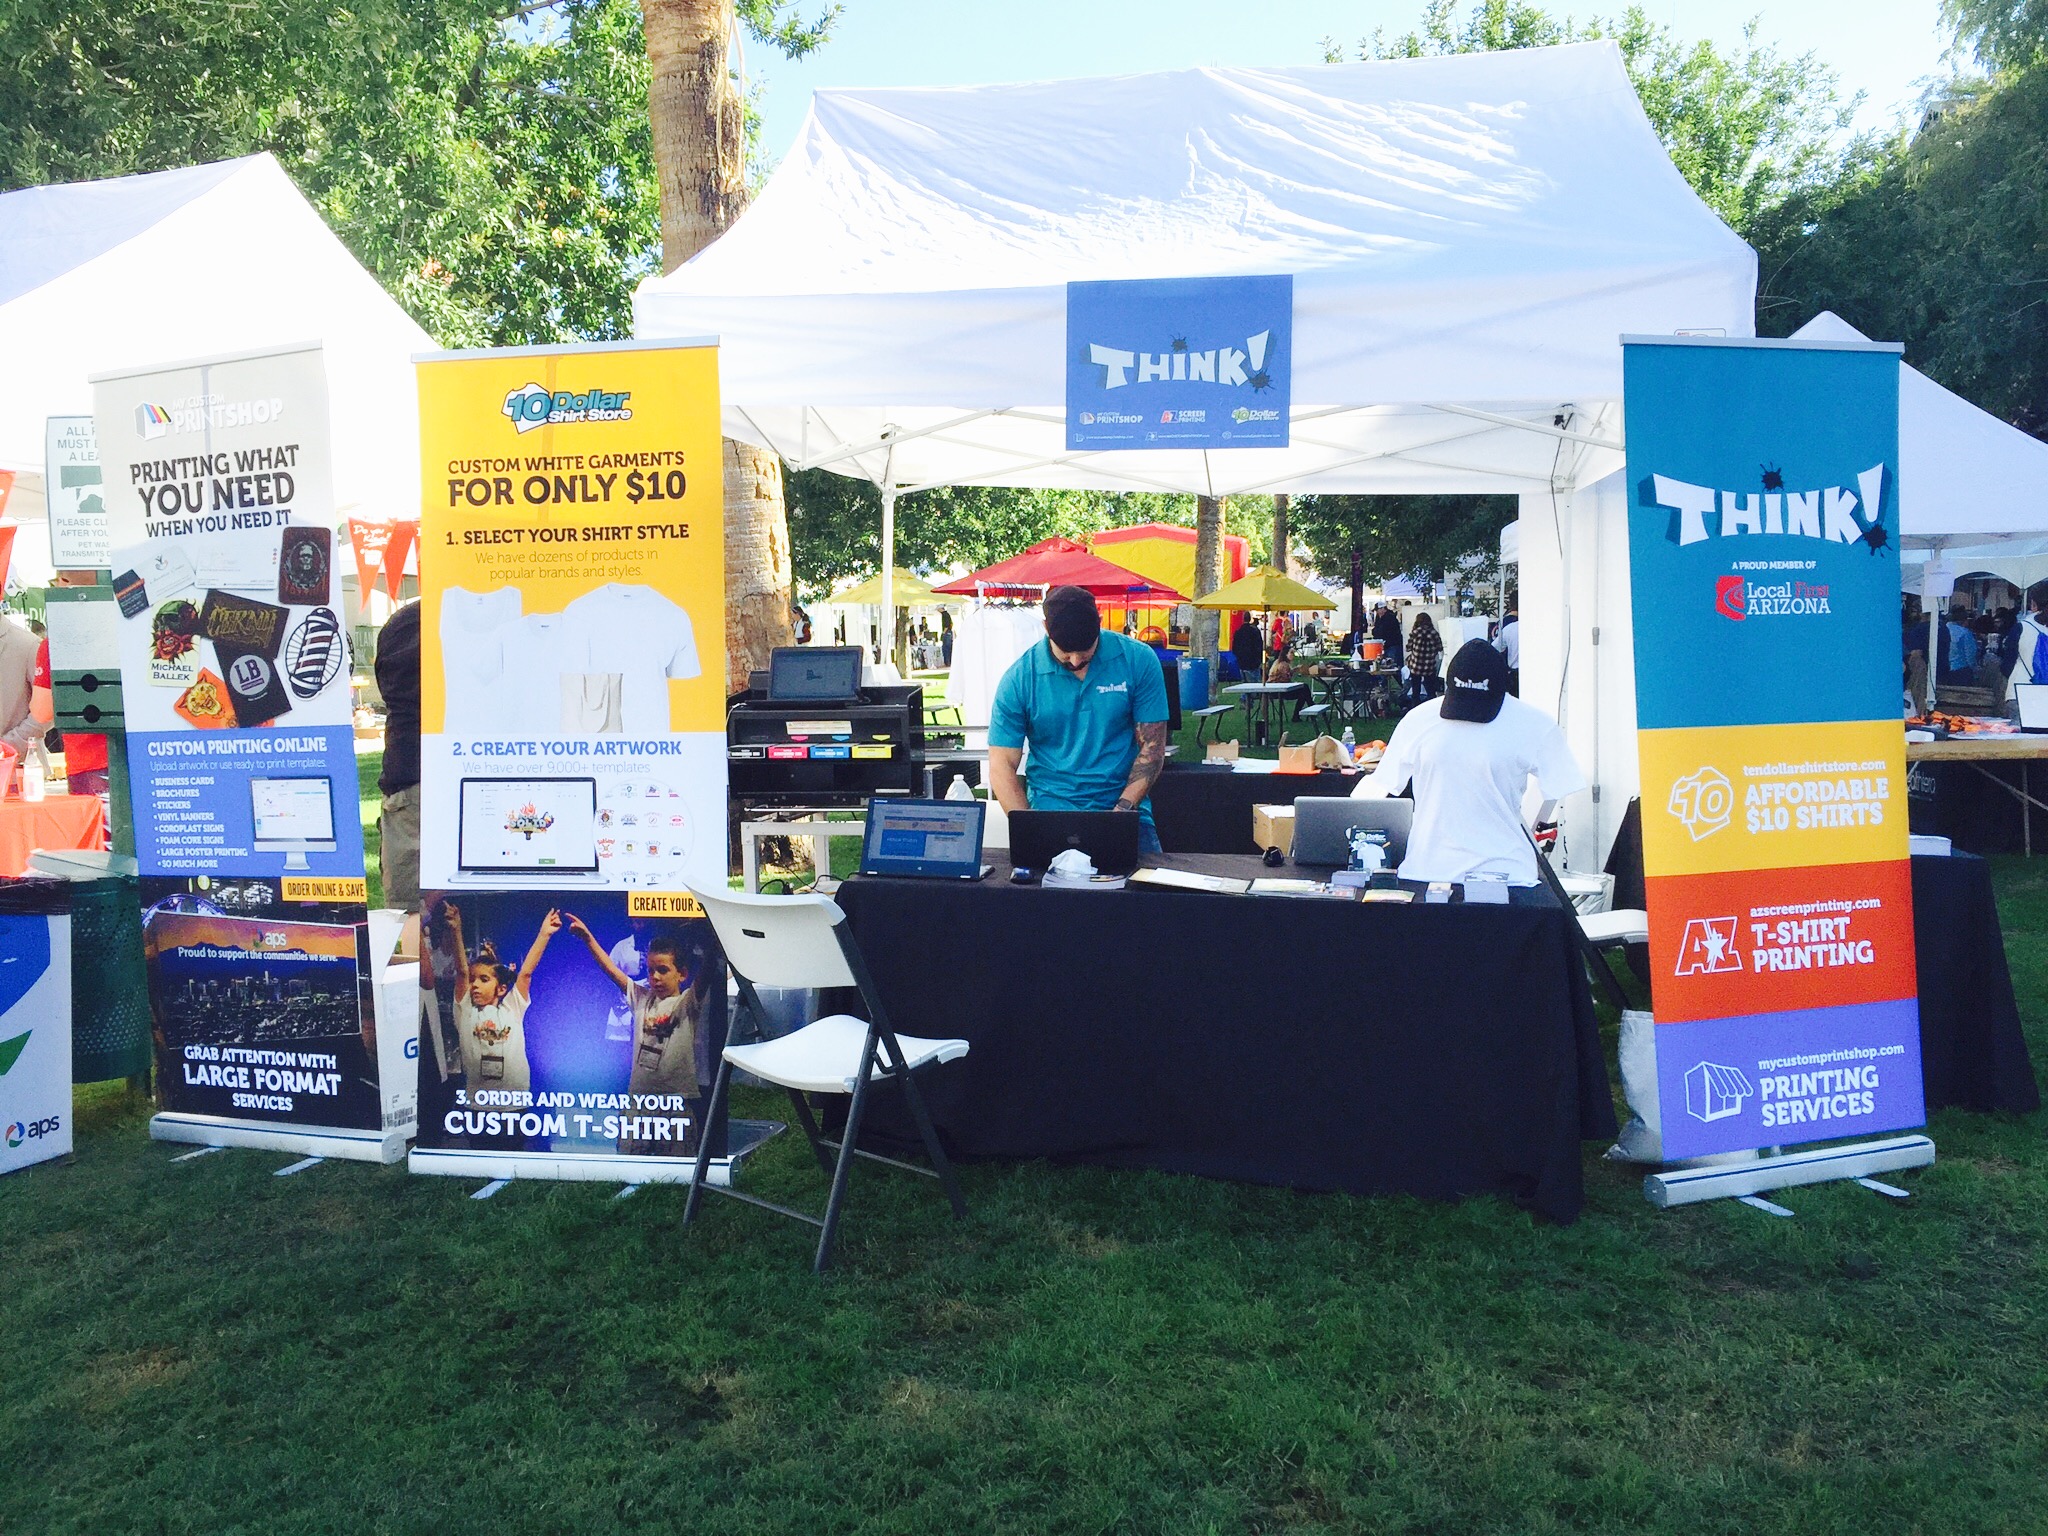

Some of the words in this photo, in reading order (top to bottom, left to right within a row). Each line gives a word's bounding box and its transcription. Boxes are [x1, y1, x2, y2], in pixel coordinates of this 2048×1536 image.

[1089, 329, 1272, 391] THINK!
[173, 399, 187, 410] MY
[188, 394, 224, 406] CUSTOM
[507, 392, 552, 421] 10
[552, 389, 631, 411] Dollar
[173, 398, 283, 433] PRINTSHOP
[548, 410, 587, 423] Shirt
[587, 408, 633, 422] Store
[1096, 415, 1143, 424] PRINTSHOP
[66, 426, 88, 436] ALL
[58, 439, 90, 449] MUST
[69, 452, 77, 461] A
[130, 453, 230, 484] PRINTING
[234, 444, 299, 473] WHAT
[448, 457, 520, 474] CUSTOM
[524, 455, 584, 472] WHITE
[590, 451, 685, 468] GARMENTS
[138, 481, 203, 517] YOU
[212, 472, 295, 510] NEED
[448, 477, 514, 507] FOR
[523, 473, 617, 504] ONLY
[626, 469, 686, 504] $10
[1653, 462, 1887, 550] THINK!
[57, 518, 91, 526] PLEASE
[146, 519, 193, 537] WHEN
[196, 515, 227, 533] YOU
[231, 511, 272, 530] NEED
[276, 509, 291, 525] IT
[446, 532, 458, 545] 1.
[463, 528, 525, 545] SELECT
[528, 527, 578, 543] YOUR
[582, 526, 632, 541] SHIRT
[637, 524, 690, 540] STYLE
[61, 550, 104, 558] TRANSMITS
[475, 552, 494, 564] We
[497, 551, 526, 563] have
[529, 550, 572, 563] dozens
[576, 550, 589, 562] of
[592, 549, 643, 565] products
[647, 549, 658, 560] in
[490, 567, 534, 581] popular
[539, 566, 580, 578] brands
[583, 565, 604, 577] and
[607, 564, 643, 580] styles.
[1732, 562, 1738, 570] A
[1739, 561, 1768, 570] PROUD
[1769, 561, 1804, 570] MEMBER
[1805, 561, 1816, 569] OF
[1747, 582, 1792, 598] Local
[1795, 581, 1829, 597] First
[1747, 598, 1831, 615] ARIZONA
[151, 663, 194, 672] MICHAEL
[234, 659, 261, 684] LB
[148, 741, 206, 757] CUSTOM
[207, 739, 271, 755] PRINTING
[274, 737, 327, 754] ONLINE
[453, 743, 466, 756] 2.
[471, 742, 537, 756] CREATE
[540, 742, 591, 755] YOUR
[593, 741, 682, 755] ARTWORK
[150, 761, 177, 772] Upload
[179, 760, 209, 770] artwork
[210, 762, 218, 770] or
[220, 762, 232, 770] use
[234, 759, 254, 772] ready
[257, 760, 265, 769] to
[267, 759, 285, 771] print
[287, 757, 327, 770] templates.
[463, 762, 481, 773] We
[485, 762, 513, 773] have
[516, 764, 544, 773] over
[547, 762, 589, 774] 9,000+
[592, 761, 651, 775] templates
[1743, 760, 1886, 776] tendollarshirtstore.com
[155, 777, 189, 786] BUSINESS
[190, 776, 214, 785] CARDS
[156, 788, 200, 798] BROCHURES
[1744, 778, 1889, 806] AFFORDABLE
[157, 801, 191, 809] STICKERS
[1674, 780, 1734, 824] 10
[158, 812, 179, 821] VINYL
[180, 812, 214, 821] BANNERS
[1746, 806, 1789, 835] $10
[1796, 802, 1883, 830] SHIRTS
[159, 824, 202, 833] COROPLAST
[203, 824, 224, 832] SIGNS
[160, 836, 180, 844] FOAM
[181, 836, 202, 844] CORE
[203, 836, 224, 844] SIGNS
[161, 848, 184, 856] LARGE
[185, 848, 213, 856] POSTER
[214, 848, 248, 857] PRINTING
[162, 860, 171, 868] SO
[173, 860, 196, 868] MUCH
[197, 860, 218, 868] MORE
[287, 883, 310, 895] ORDER
[312, 883, 337, 896] ONLINE
[339, 884, 344, 896] &
[346, 884, 364, 897] SAVE
[634, 897, 667, 911] CREATE
[670, 897, 694, 911] YOUR
[1750, 898, 1881, 918] azscreenprinting.com
[265, 932, 287, 948] aps
[1751, 917, 1851, 947] T-SHIRT
[178, 947, 205, 958] Proud
[207, 948, 217, 958] to
[218, 949, 249, 961] support
[250, 950, 262, 960] the
[263, 950, 308, 961] communities
[309, 953, 318, 961] we
[319, 953, 338, 962] serve.
[1753, 940, 1875, 973] PRINTING
[184, 1046, 219, 1061] GRAB
[221, 1047, 296, 1067] ATTENTION
[298, 1053, 337, 1069] WITH
[1758, 1044, 1905, 1072] mycustomprintshop.com
[183, 1064, 250, 1089] LARGE
[254, 1069, 341, 1096] FORMAT
[1760, 1065, 1880, 1101] PRINTING
[233, 1092, 293, 1111] SERVICES
[455, 1090, 471, 1105] 3.
[474, 1090, 532, 1107] ORDER
[536, 1091, 575, 1108] AND
[579, 1093, 631, 1110] WEAR
[633, 1094, 684, 1112] YOUR
[1762, 1091, 1875, 1127] SERVICES
[27, 1115, 60, 1140] aps
[444, 1112, 566, 1137] CUSTOM
[574, 1115, 690, 1141] T-SHIRT
